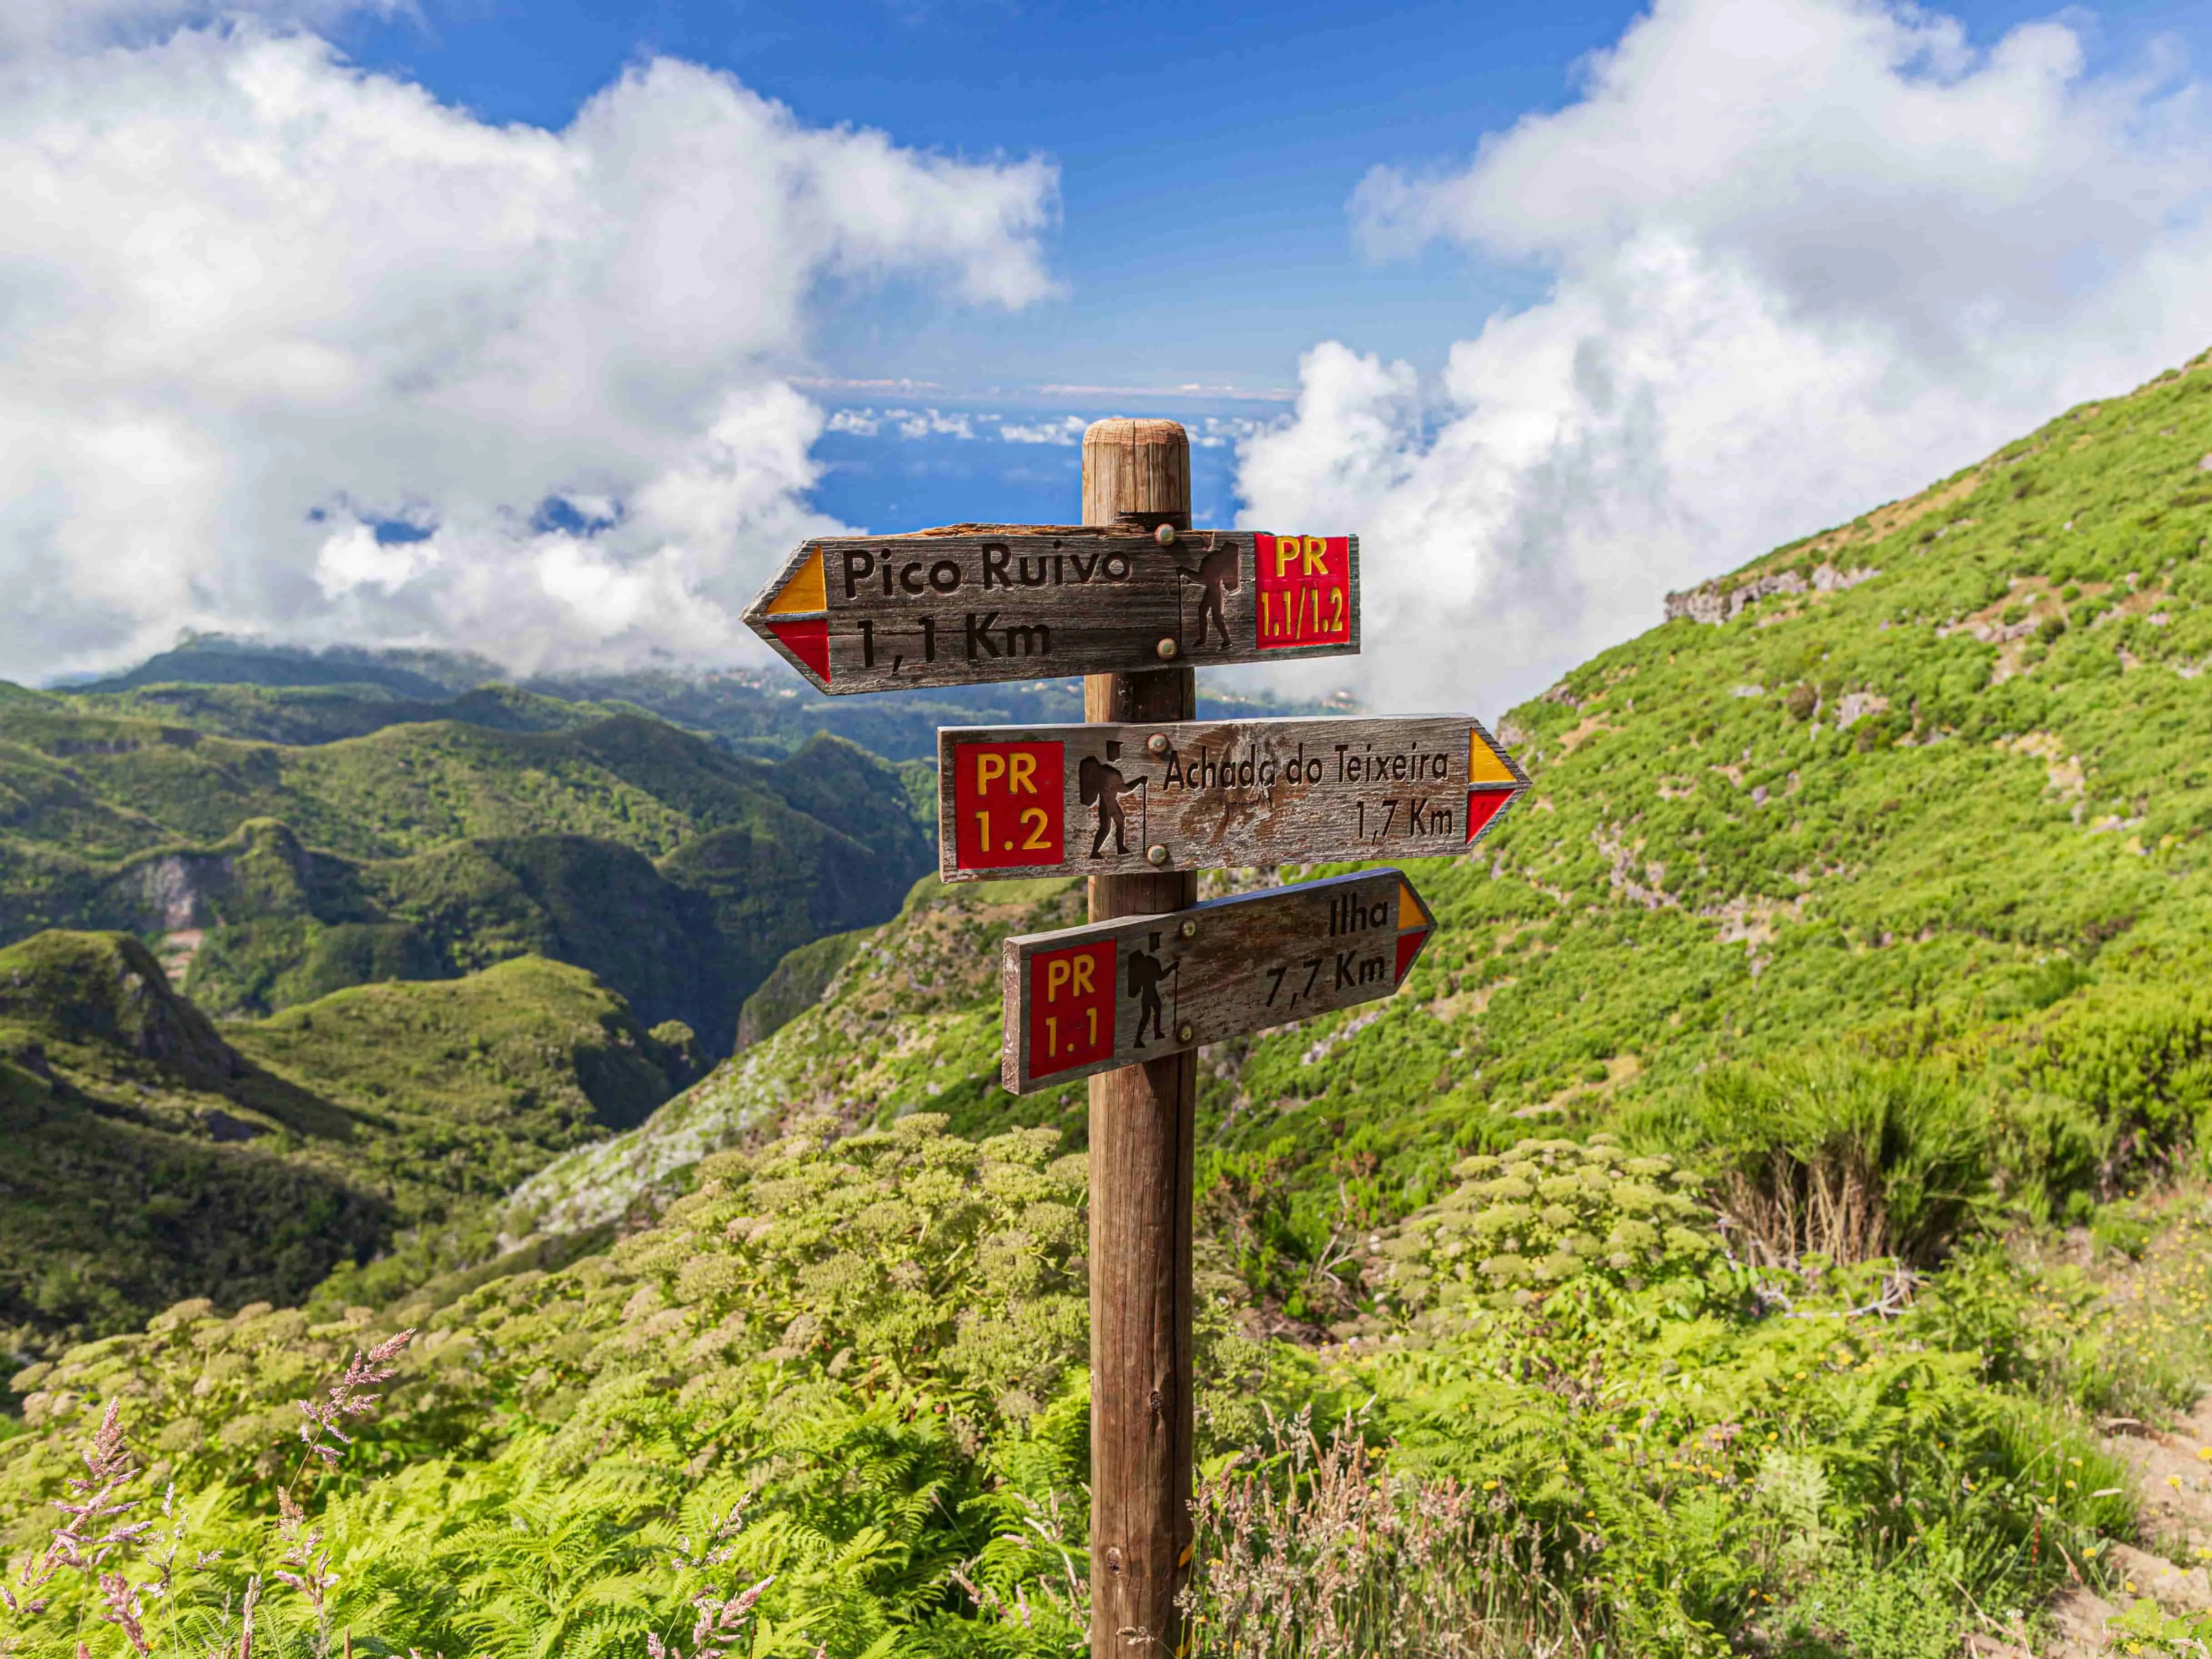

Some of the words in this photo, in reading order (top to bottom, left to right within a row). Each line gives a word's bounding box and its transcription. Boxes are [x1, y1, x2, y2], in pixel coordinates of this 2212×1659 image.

[844, 548, 962, 599] Pico
[982, 540, 1134, 592] Ruivo
[1275, 536, 1328, 577] PR
[1261, 584, 1344, 640] 1.1/1.2
[855, 614, 937, 677] 1,1
[965, 611, 1053, 663] Km
[976, 752, 1037, 796] PR
[1162, 742, 1277, 791] Achada
[1286, 744, 1323, 786] do
[1334, 741, 1450, 785] Teixeira
[975, 808, 1052, 853] 1.2
[1355, 798, 1399, 846] 1,7
[1409, 798, 1454, 837] Km
[1328, 893, 1389, 938] Ilha
[1047, 954, 1096, 1003] PR
[1266, 959, 1323, 1010] 7,7
[1335, 950, 1386, 990] Km
[1045, 1007, 1098, 1059] 1.1
